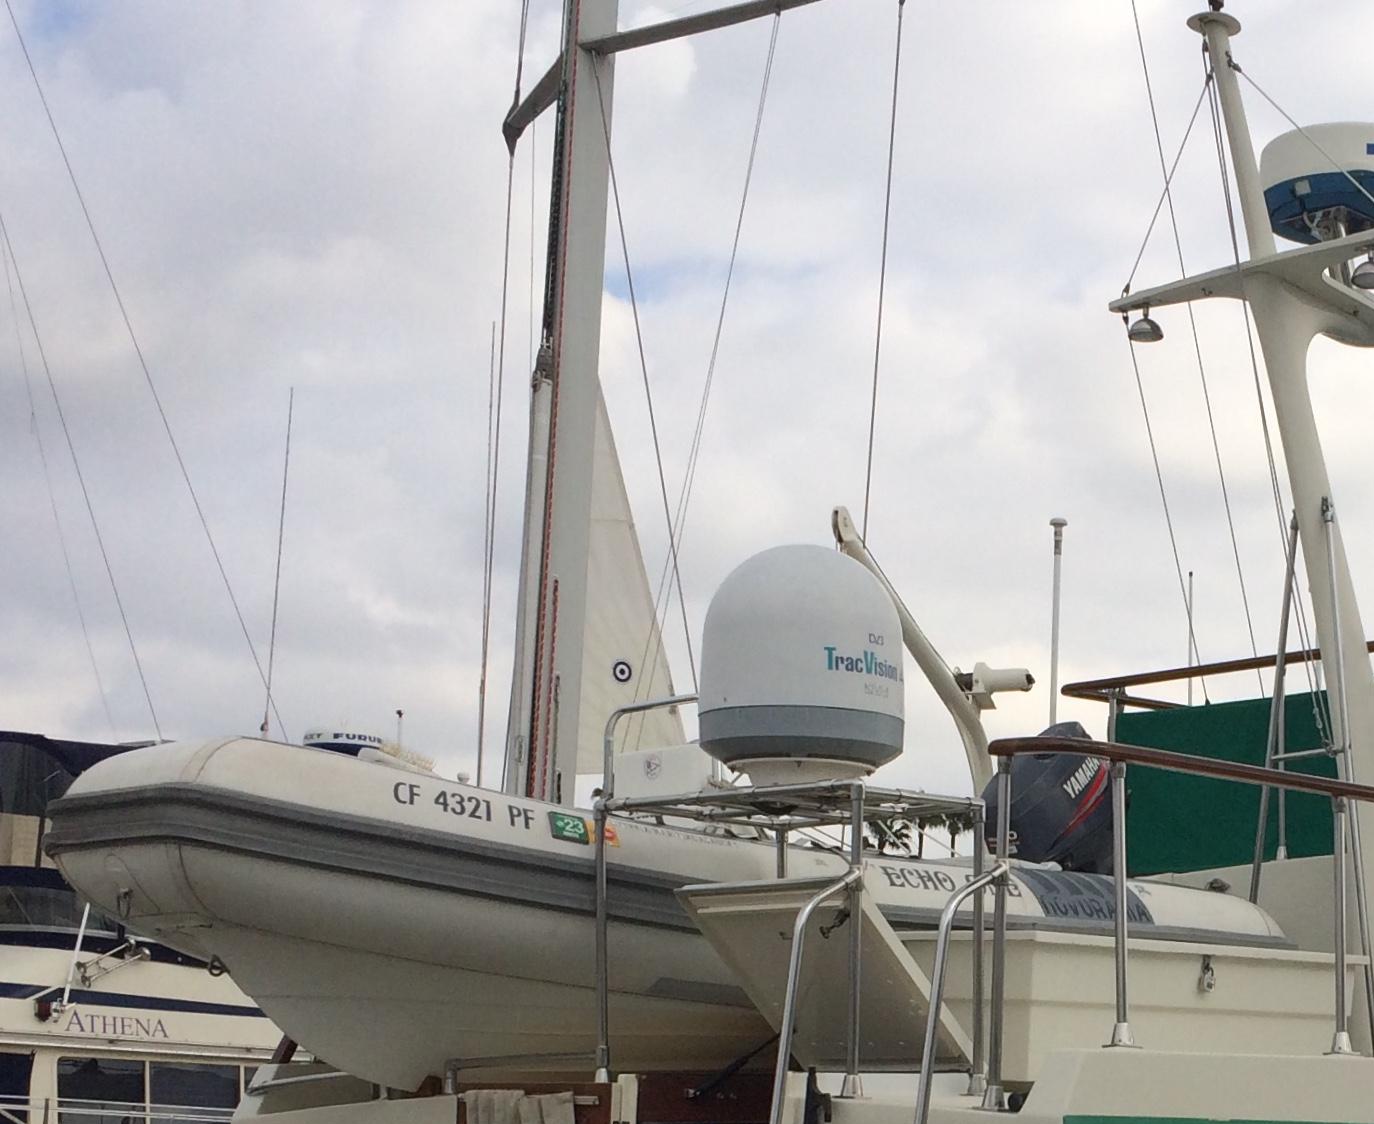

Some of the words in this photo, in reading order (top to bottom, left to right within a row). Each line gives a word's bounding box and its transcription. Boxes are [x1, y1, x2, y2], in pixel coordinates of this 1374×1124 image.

[823, 646, 898, 682] TracVision
[1062, 756, 1100, 800] YAMAHA
[393, 782, 421, 805] CF
[434, 790, 492, 822] 4321
[507, 804, 535, 830] PF
[879, 865, 957, 893] ECHO
[64, 1009, 169, 1038] ATHENA
